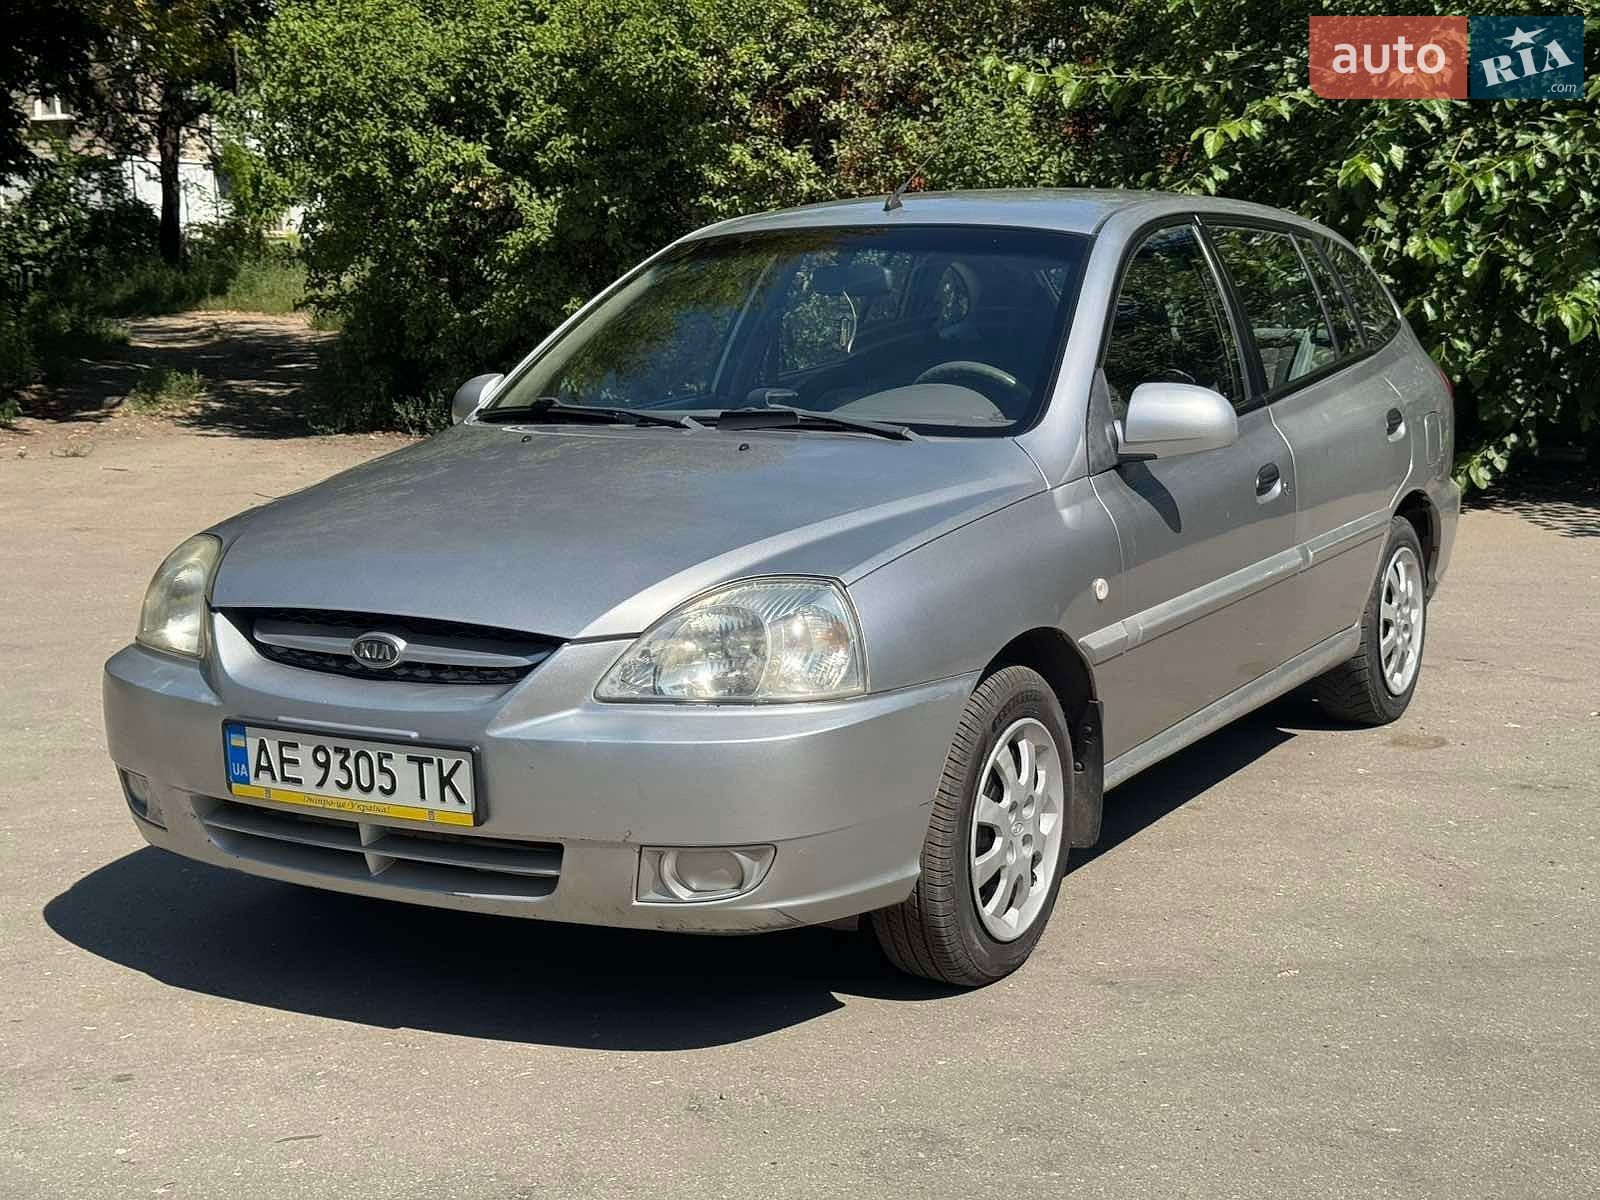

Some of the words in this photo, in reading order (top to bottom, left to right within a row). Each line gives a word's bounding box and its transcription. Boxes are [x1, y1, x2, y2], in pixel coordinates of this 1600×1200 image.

[359, 642, 391, 660] KIA
[232, 763, 248, 777] UA
[254, 738, 303, 785] AE
[312, 744, 397, 796] 9305
[407, 755, 466, 804] TK
